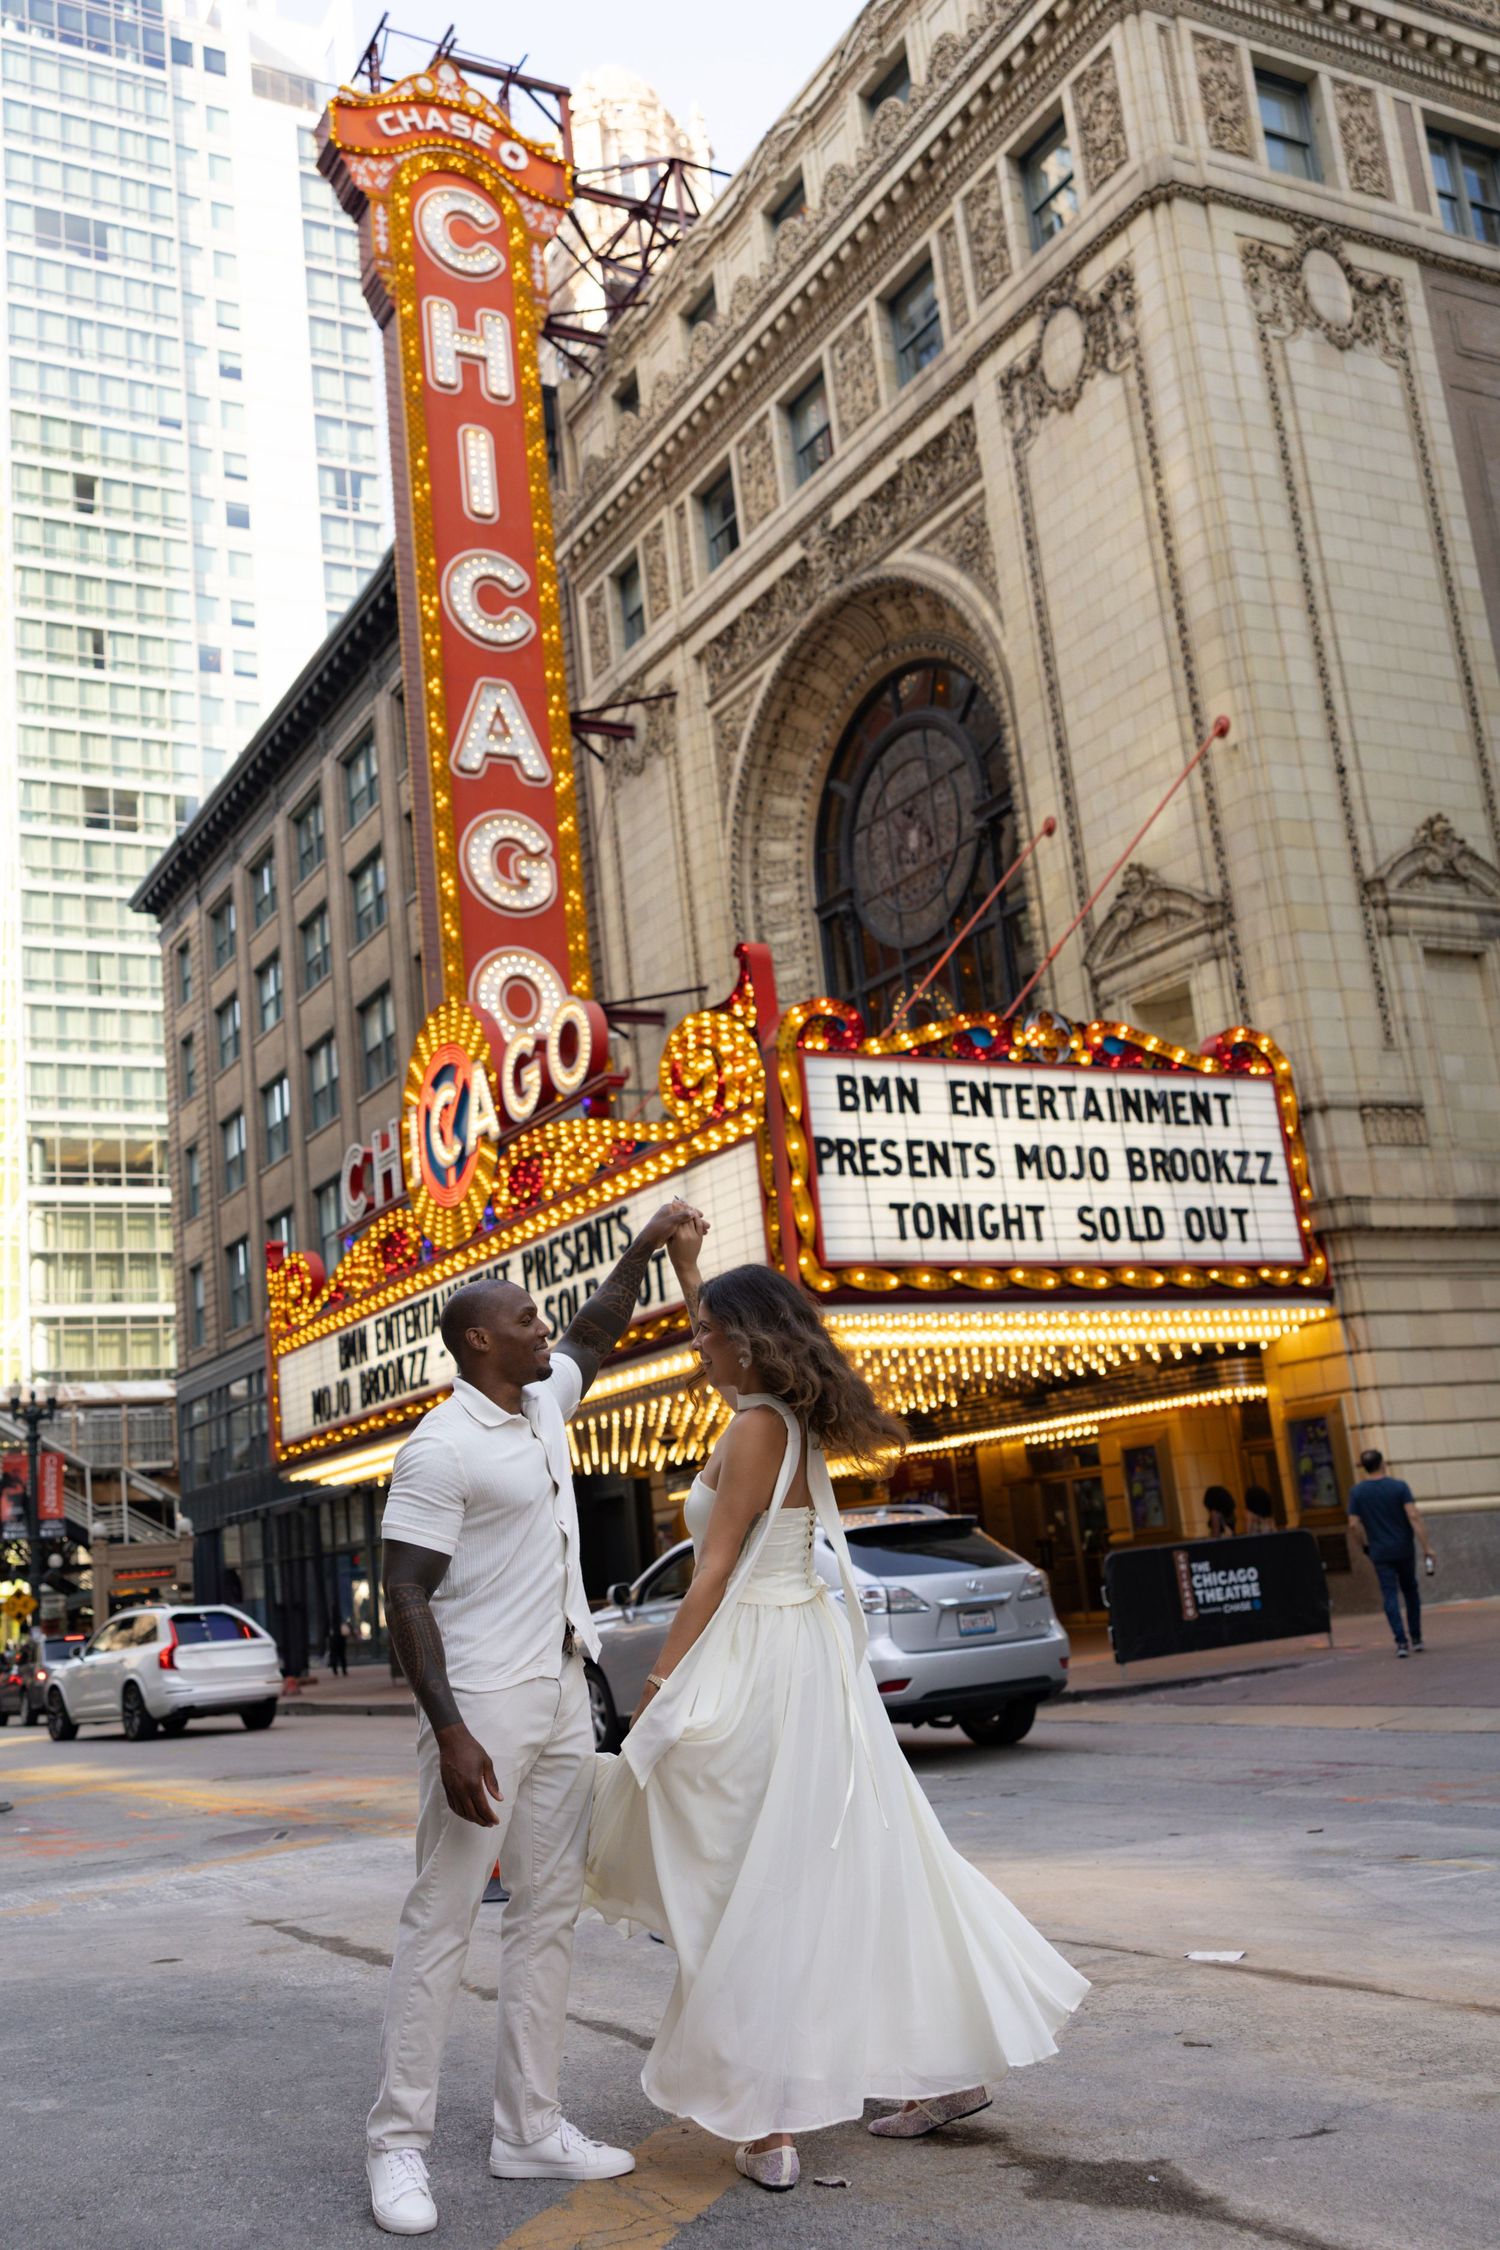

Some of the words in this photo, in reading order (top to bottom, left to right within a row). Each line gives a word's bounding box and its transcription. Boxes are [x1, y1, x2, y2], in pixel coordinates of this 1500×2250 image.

[376, 107, 496, 149] CHASE
[414, 186, 568, 1042] CHICAGO
[340, 996, 592, 1222] CHICAGO
[836, 1074, 921, 1115] BMN
[949, 1080, 1232, 1128] ENTERTAINMENT
[813, 1136, 996, 1179] PRESENTS
[1014, 1143, 1110, 1182] MOJO
[1126, 1147, 1279, 1185] BROOKZZ
[889, 1201, 1045, 1242] TONIGHT
[1077, 1205, 1165, 1243] SOLD
[1184, 1206, 1249, 1243] OUT
[338, 1324, 368, 1372] BMN
[374, 1259, 511, 1356] ENTERTAT
[521, 1205, 633, 1292] PRESENTS
[312, 1378, 350, 1426] MOJO
[359, 1346, 430, 1409] BROOKZZ
[636, 1248, 666, 1307] UT
[1191, 1561, 1211, 1573] THE
[1192, 1566, 1259, 1588] CHICAGO
[1195, 1581, 1262, 1604] THEATRE
